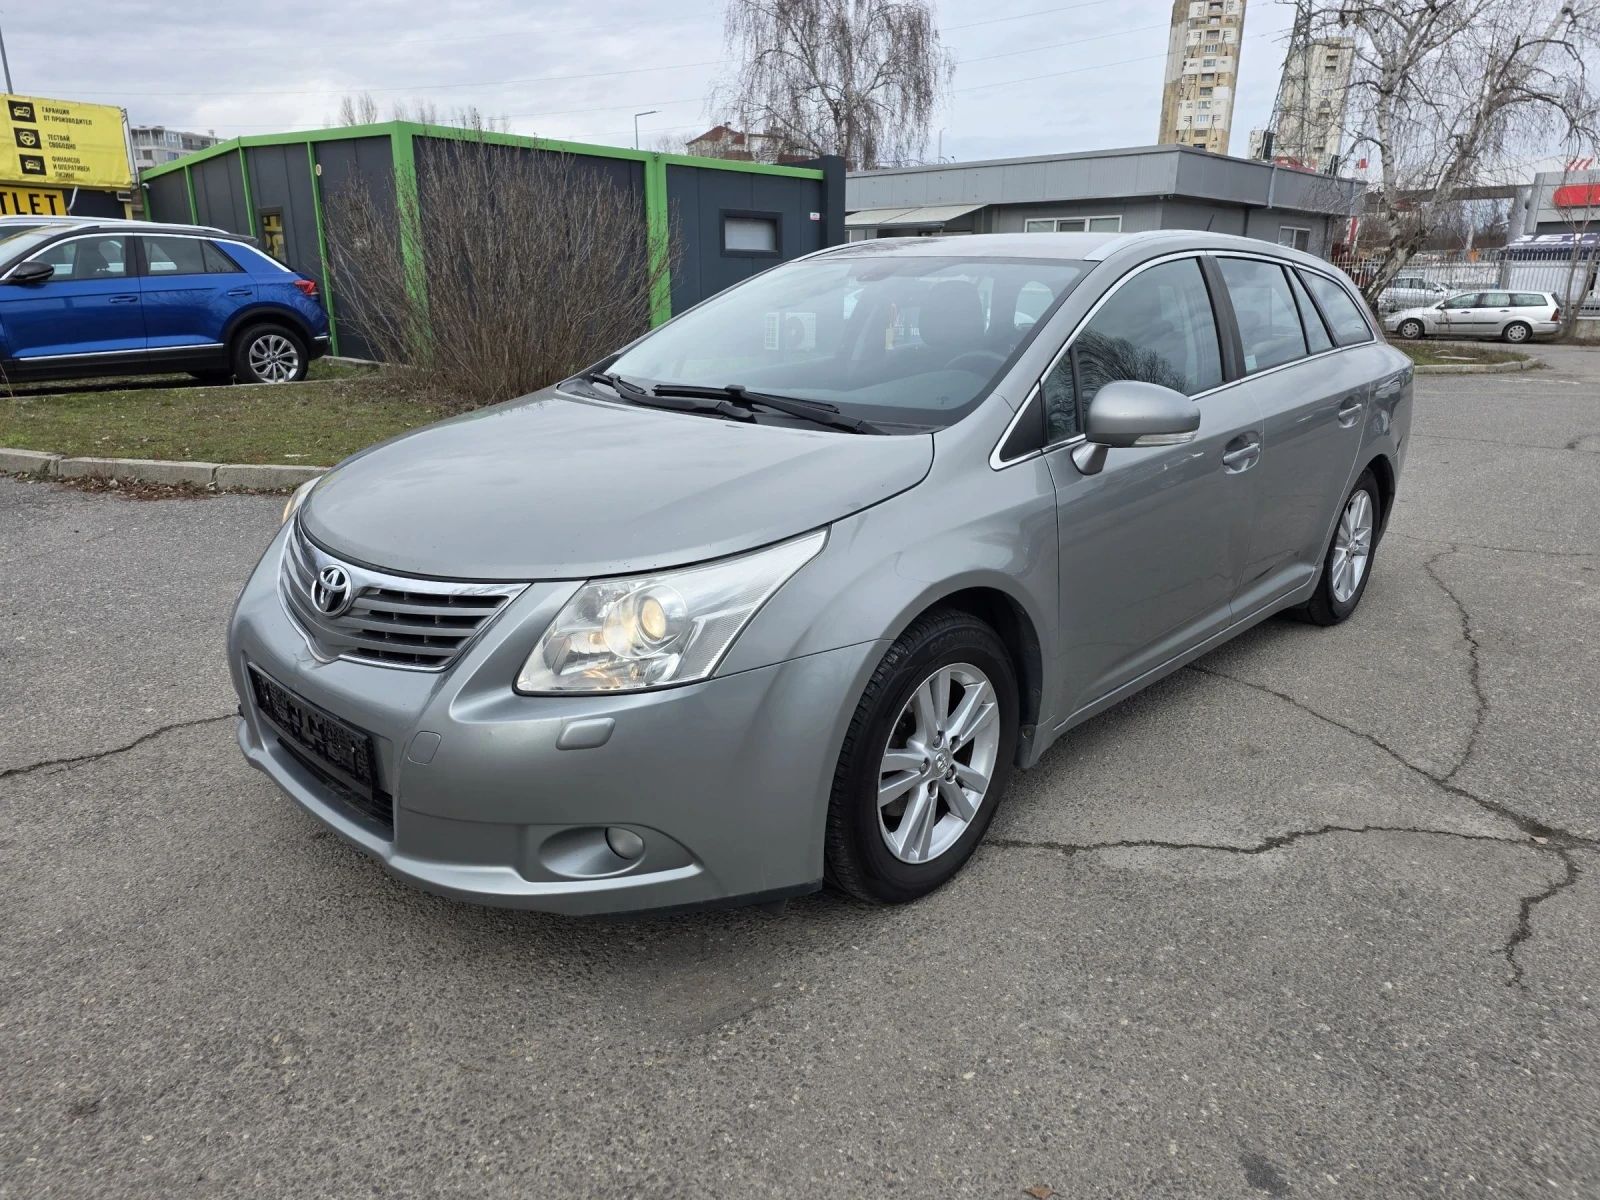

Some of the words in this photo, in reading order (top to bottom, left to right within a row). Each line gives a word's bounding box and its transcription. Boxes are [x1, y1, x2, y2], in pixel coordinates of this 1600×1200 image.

[42, 107, 70, 115] ГАРАНЦИЯ
[51, 116, 93, 125] ПРОИЗВОДИТЕЛ
[47, 134, 70, 142] ТЕСТВАЙ
[49, 142, 77, 150] СВОБОДНО
[52, 156, 81, 165] ФИНАНСОВ
[58, 165, 91, 173] ОПЕРАТИВЕН
